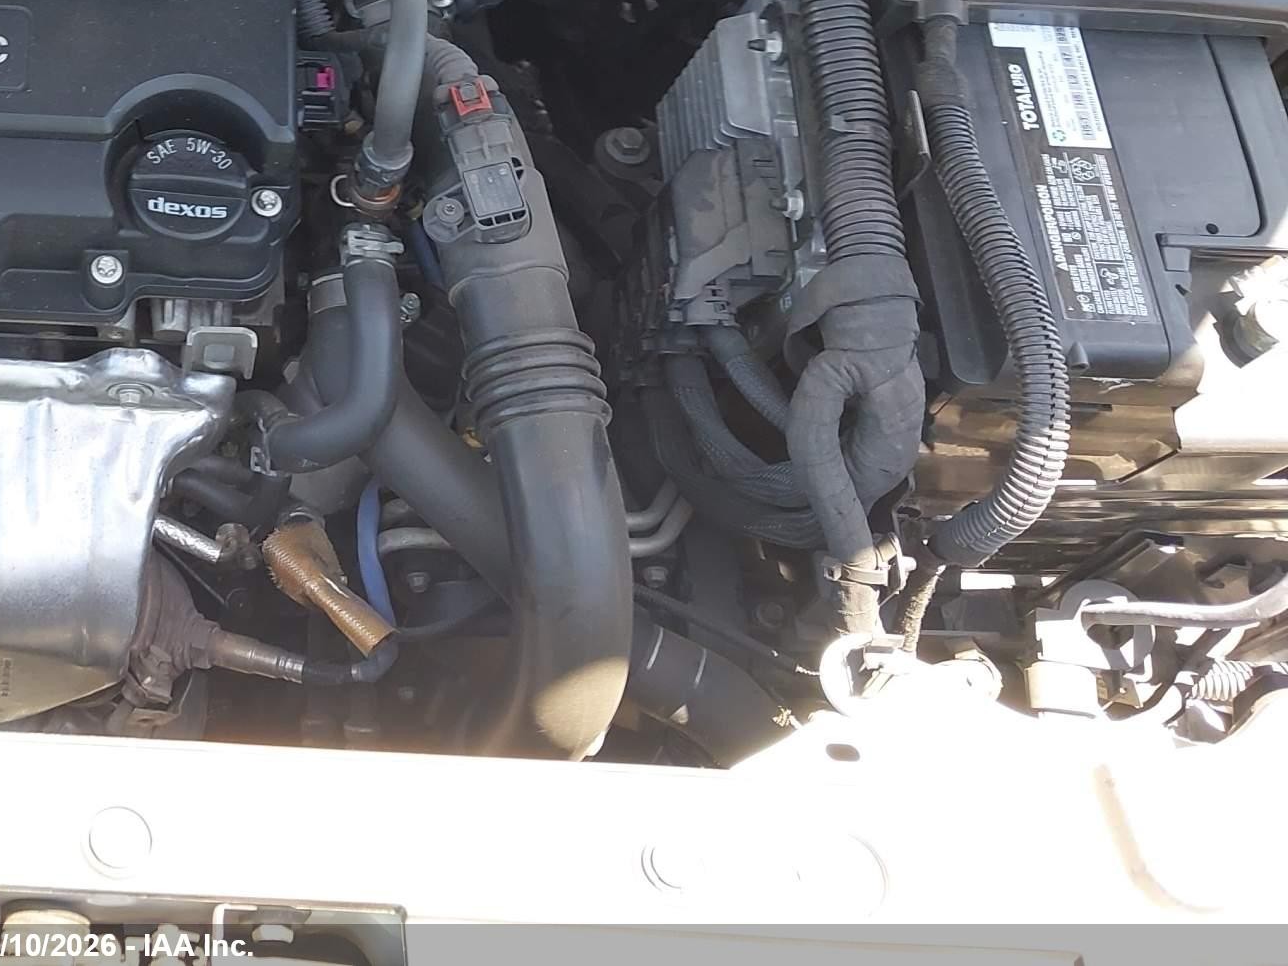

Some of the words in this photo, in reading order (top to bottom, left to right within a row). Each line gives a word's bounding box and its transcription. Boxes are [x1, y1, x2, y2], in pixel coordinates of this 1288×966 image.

[1008, 64, 1040, 130] TOTALPRO
[147, 139, 177, 163] SAE
[186, 138, 232, 169] 5W-30
[148, 197, 226, 218] dexos
[1035, 183, 1066, 261] DANGER/POISON
